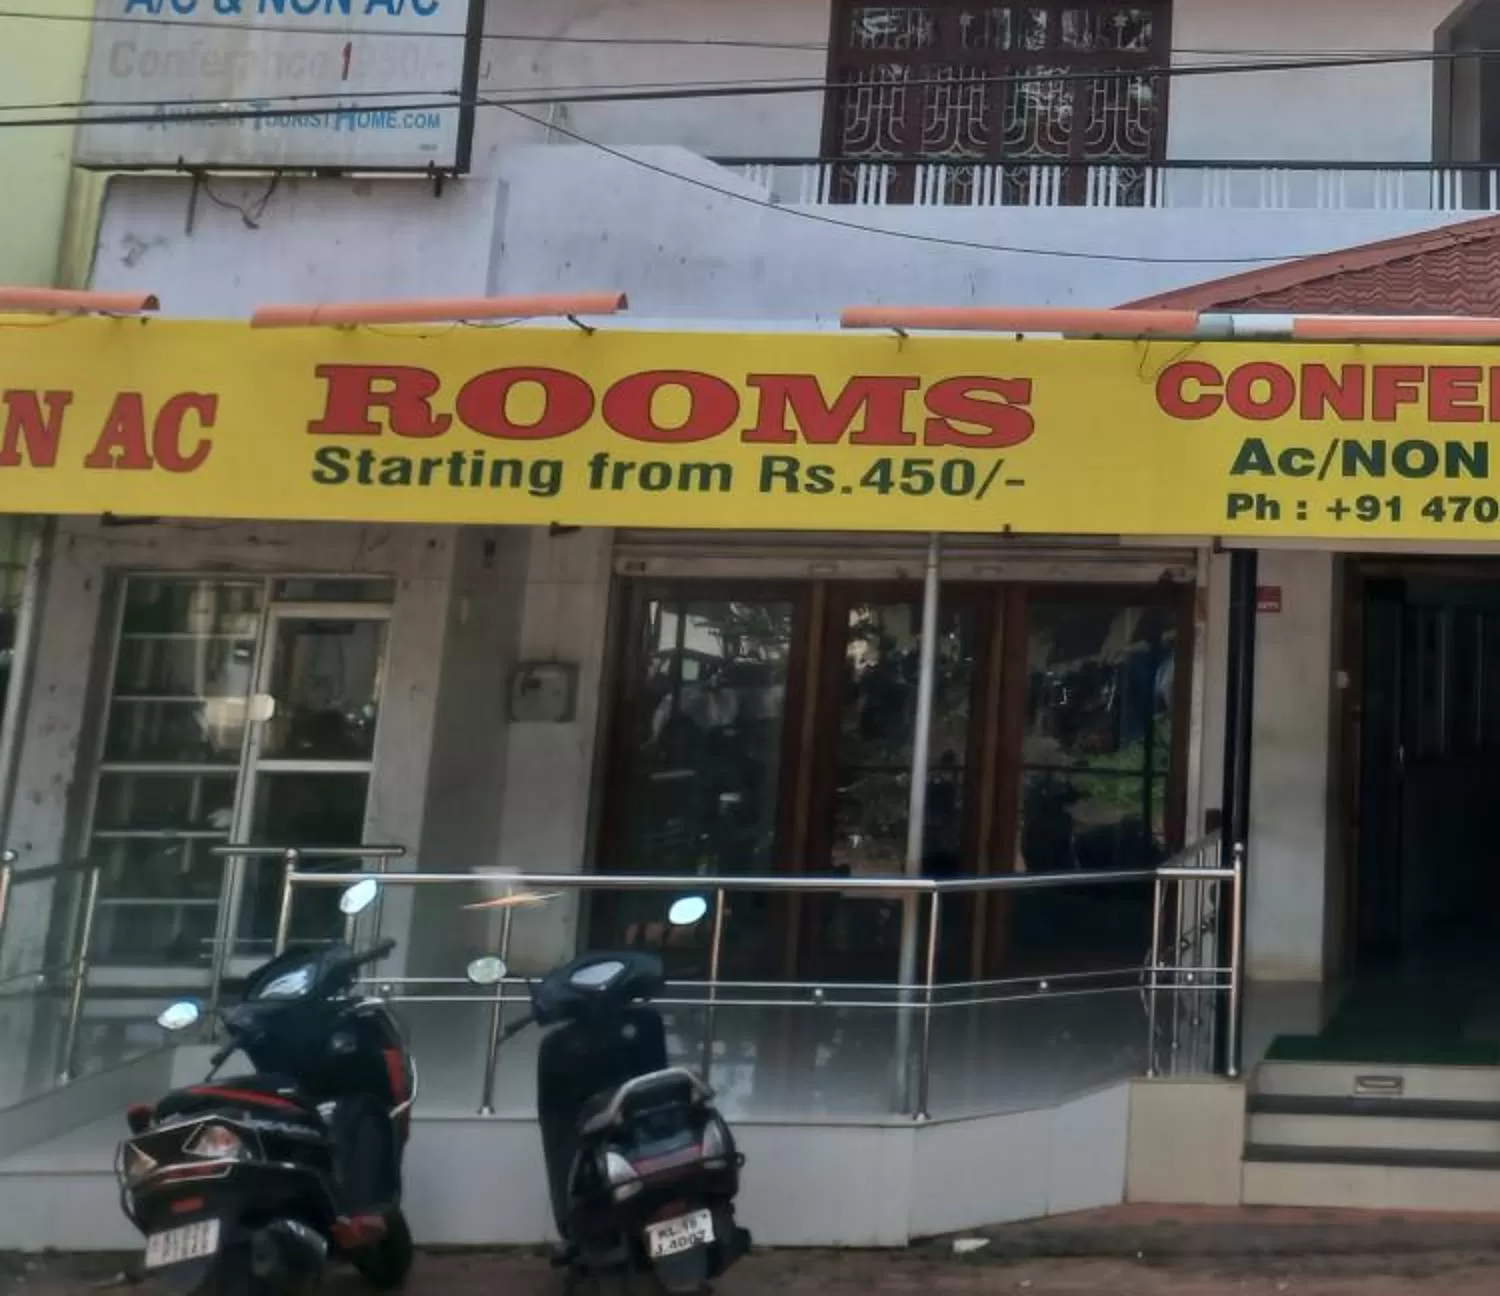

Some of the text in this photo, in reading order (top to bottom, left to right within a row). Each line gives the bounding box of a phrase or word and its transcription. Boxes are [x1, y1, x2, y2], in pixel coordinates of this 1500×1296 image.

[84, 391, 220, 473] AC
[307, 363, 1035, 450] ROOMS
[312, 445, 1026, 500] Starting from Rs.450/-
[1229, 437, 1489, 482] Ac/NON
[1326, 495, 1403, 522] +91
